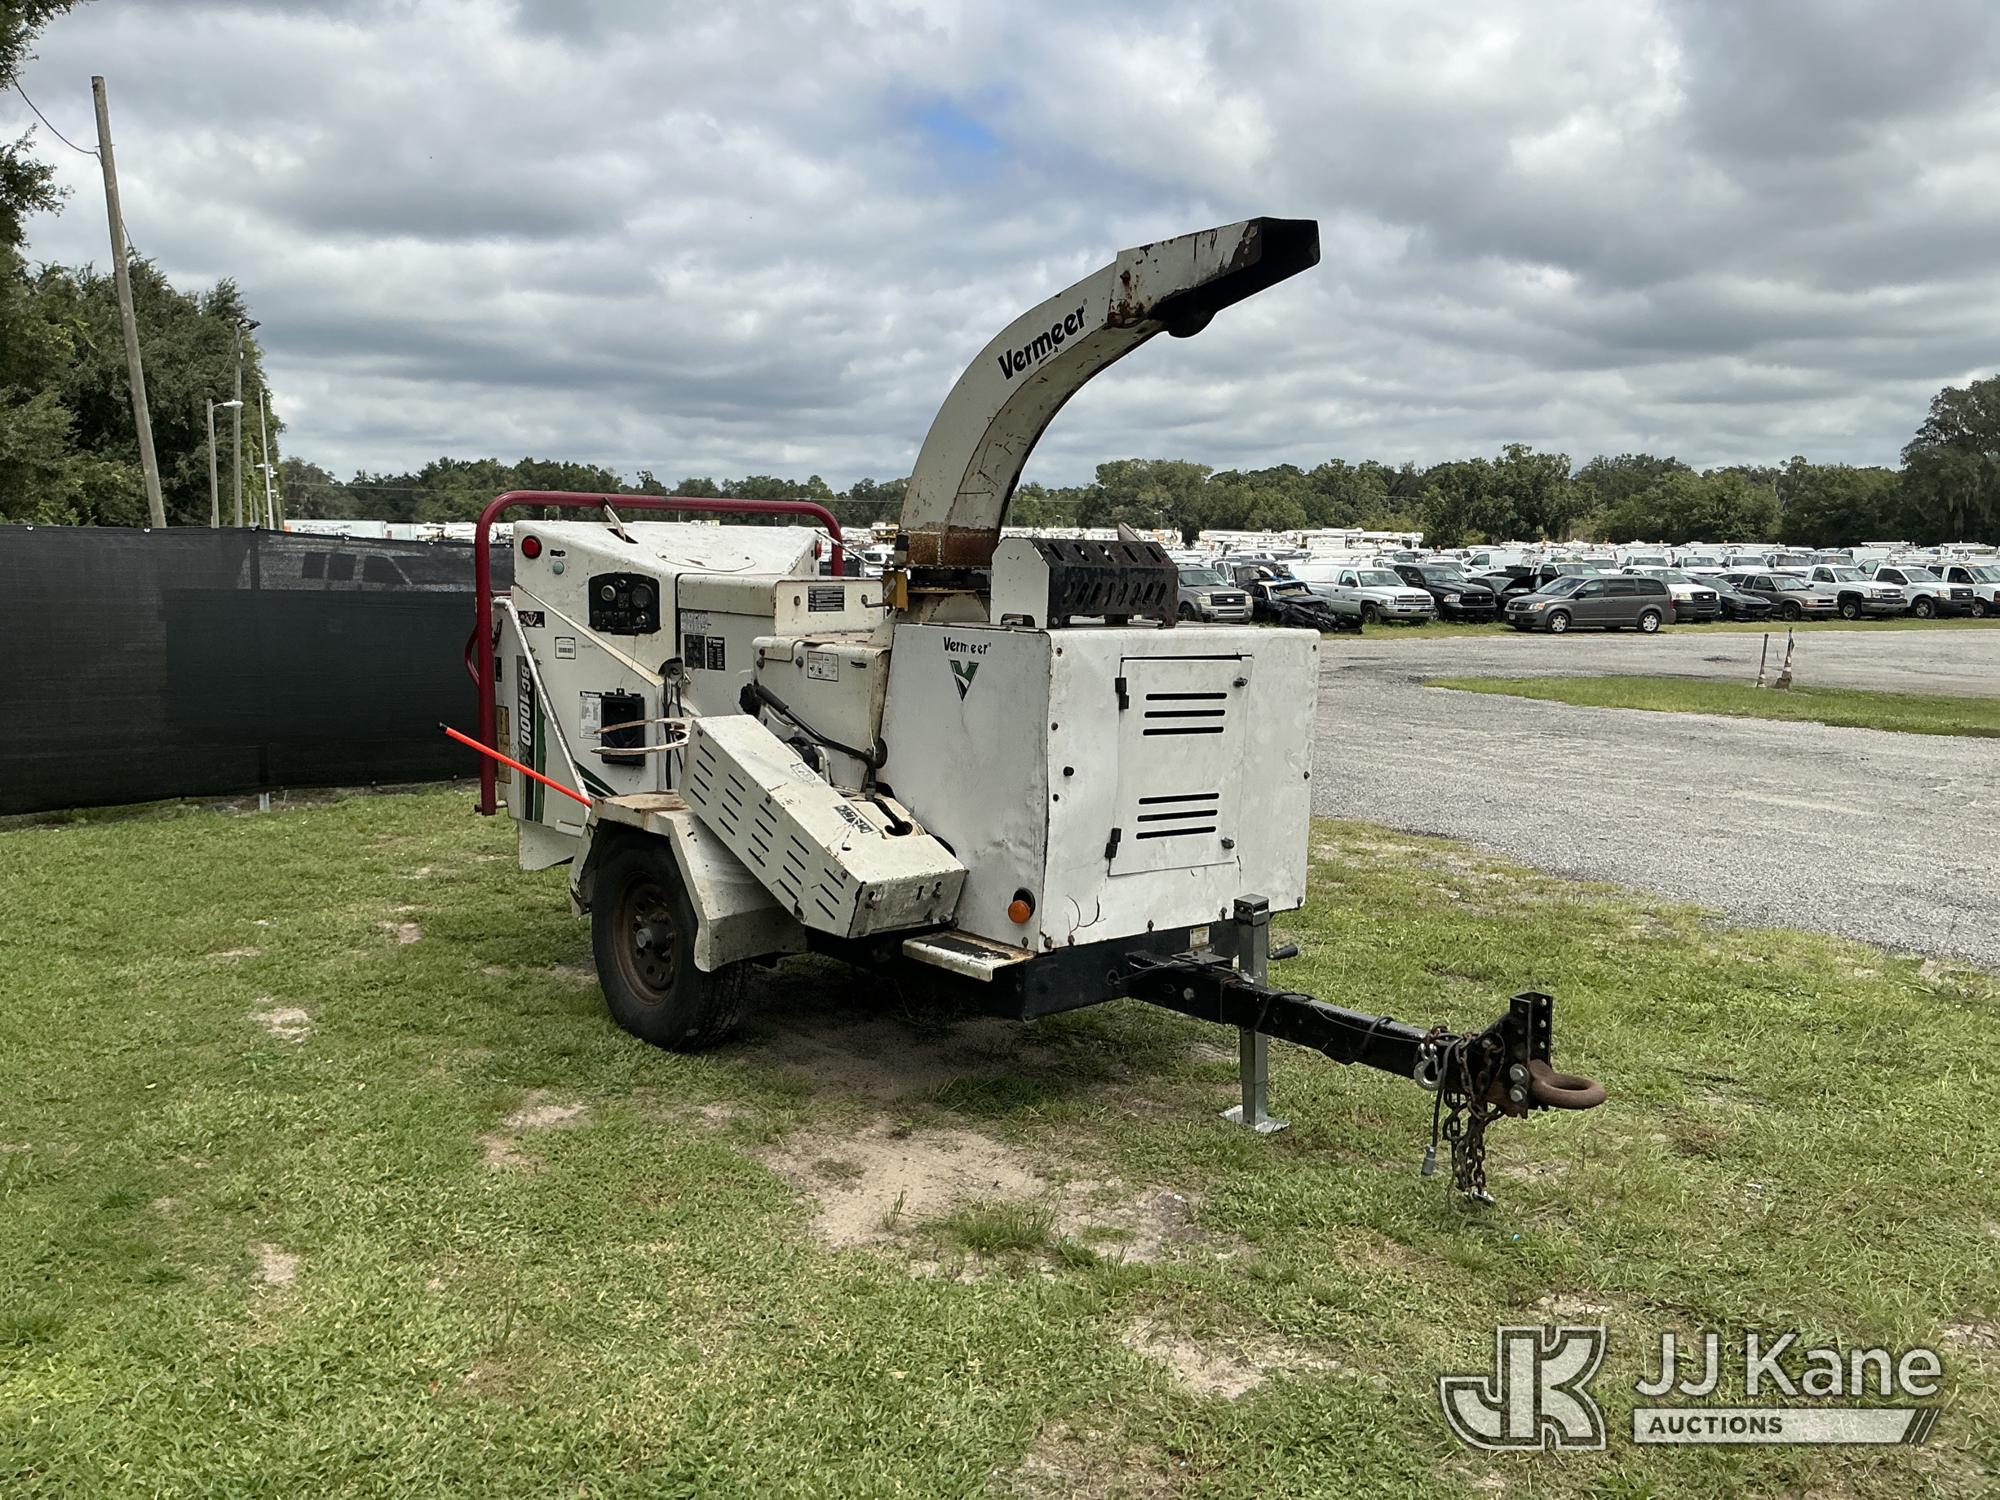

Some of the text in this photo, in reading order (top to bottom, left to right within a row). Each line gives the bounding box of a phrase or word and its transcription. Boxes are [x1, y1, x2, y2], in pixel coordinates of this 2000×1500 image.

[997, 305, 1085, 380] Vermeer
[943, 636, 988, 655] Vermeer
[519, 667, 532, 747] BC1000
